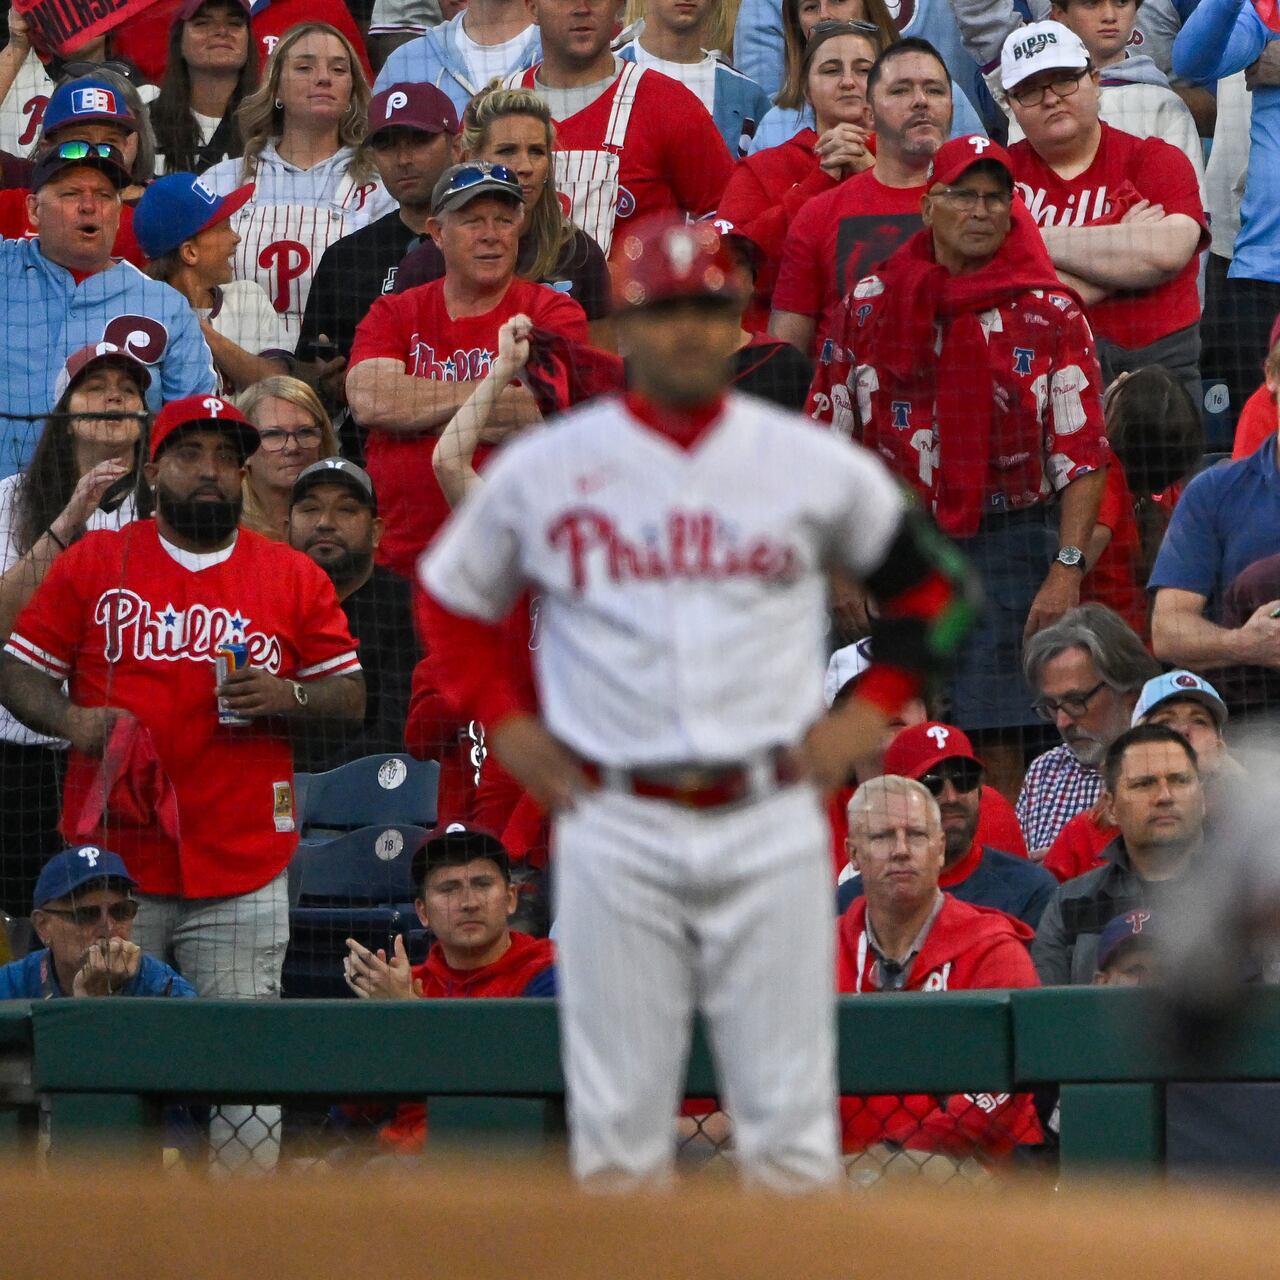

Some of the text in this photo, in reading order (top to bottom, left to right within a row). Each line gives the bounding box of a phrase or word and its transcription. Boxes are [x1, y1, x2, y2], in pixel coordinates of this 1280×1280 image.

[1013, 31, 1058, 61] BIRDS
[548, 512, 796, 591] Phillies
[95, 588, 283, 672] Phillies
